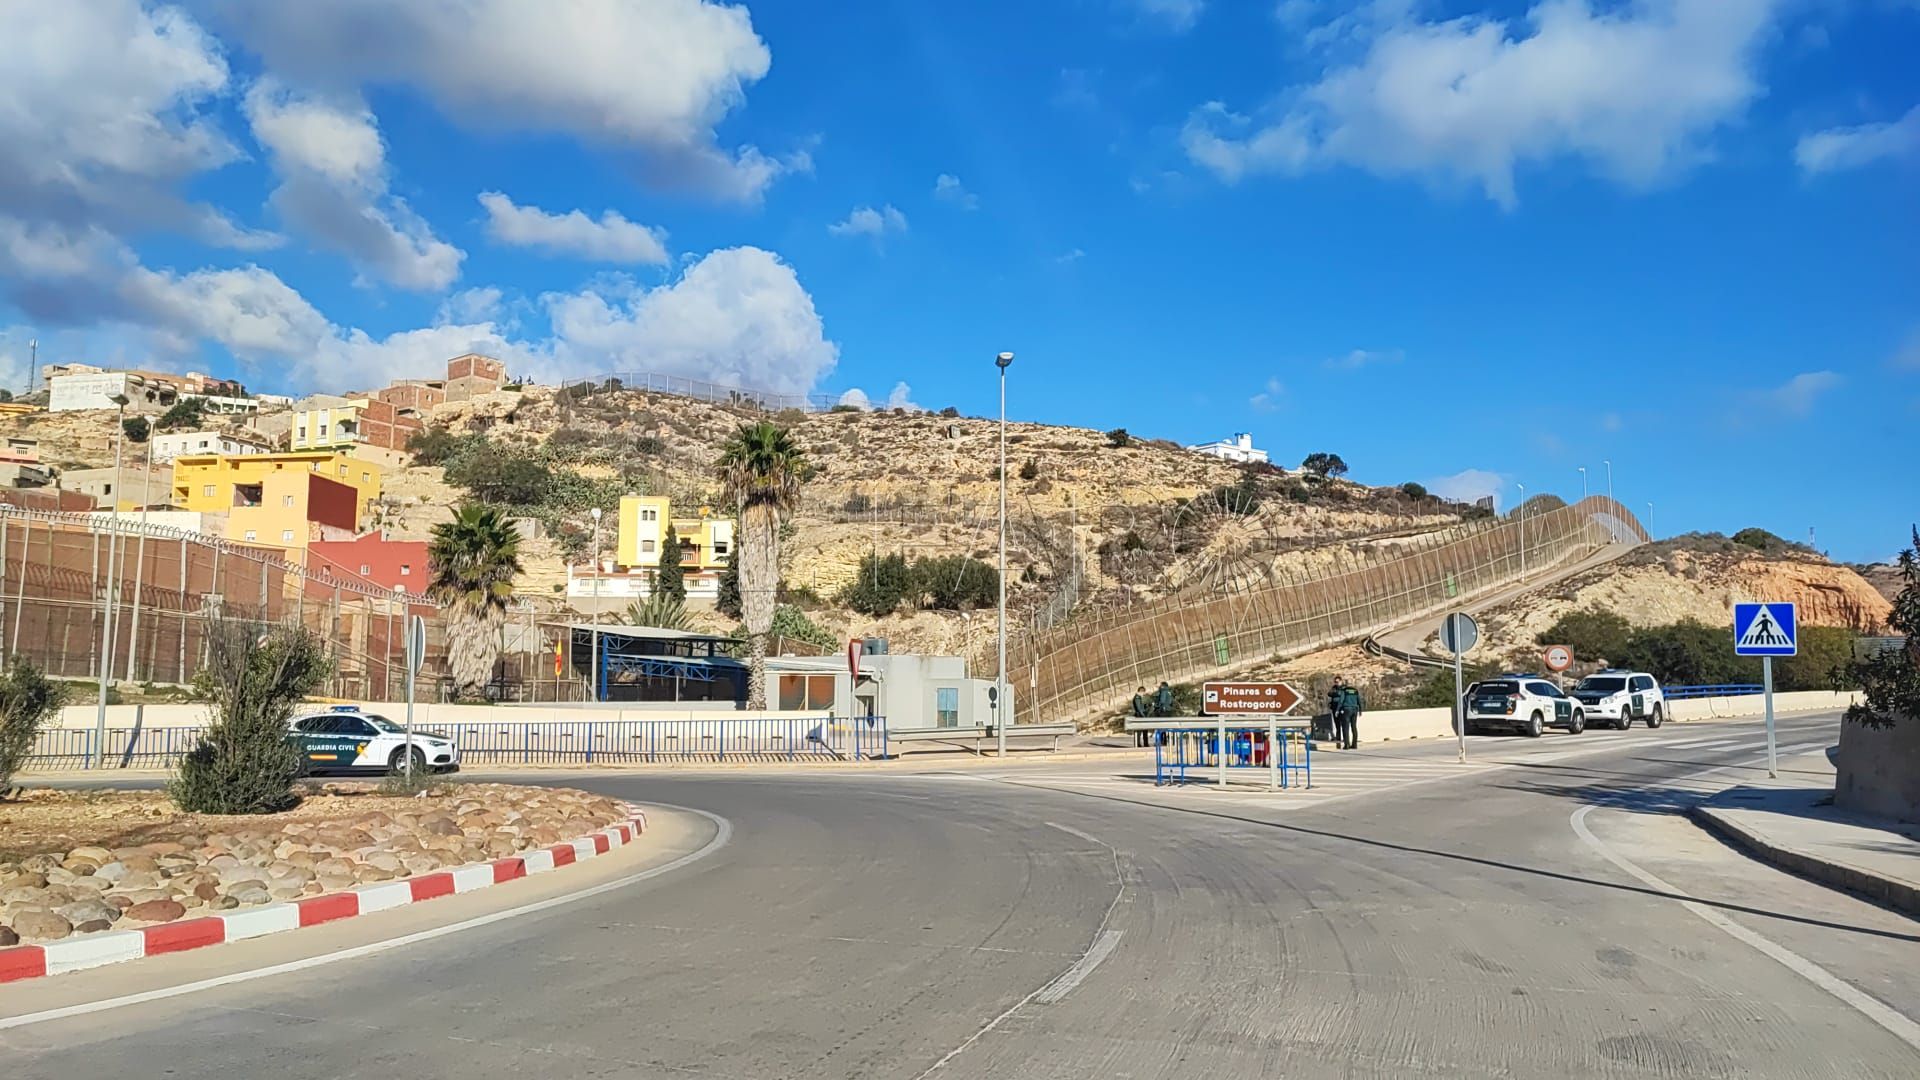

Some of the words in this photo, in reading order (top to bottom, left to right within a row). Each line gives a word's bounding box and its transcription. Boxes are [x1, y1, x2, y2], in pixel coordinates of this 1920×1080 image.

[1223, 687, 1260, 695] Pinares
[1265, 687, 1278, 695] de
[1219, 699, 1282, 710] Rostrogordo
